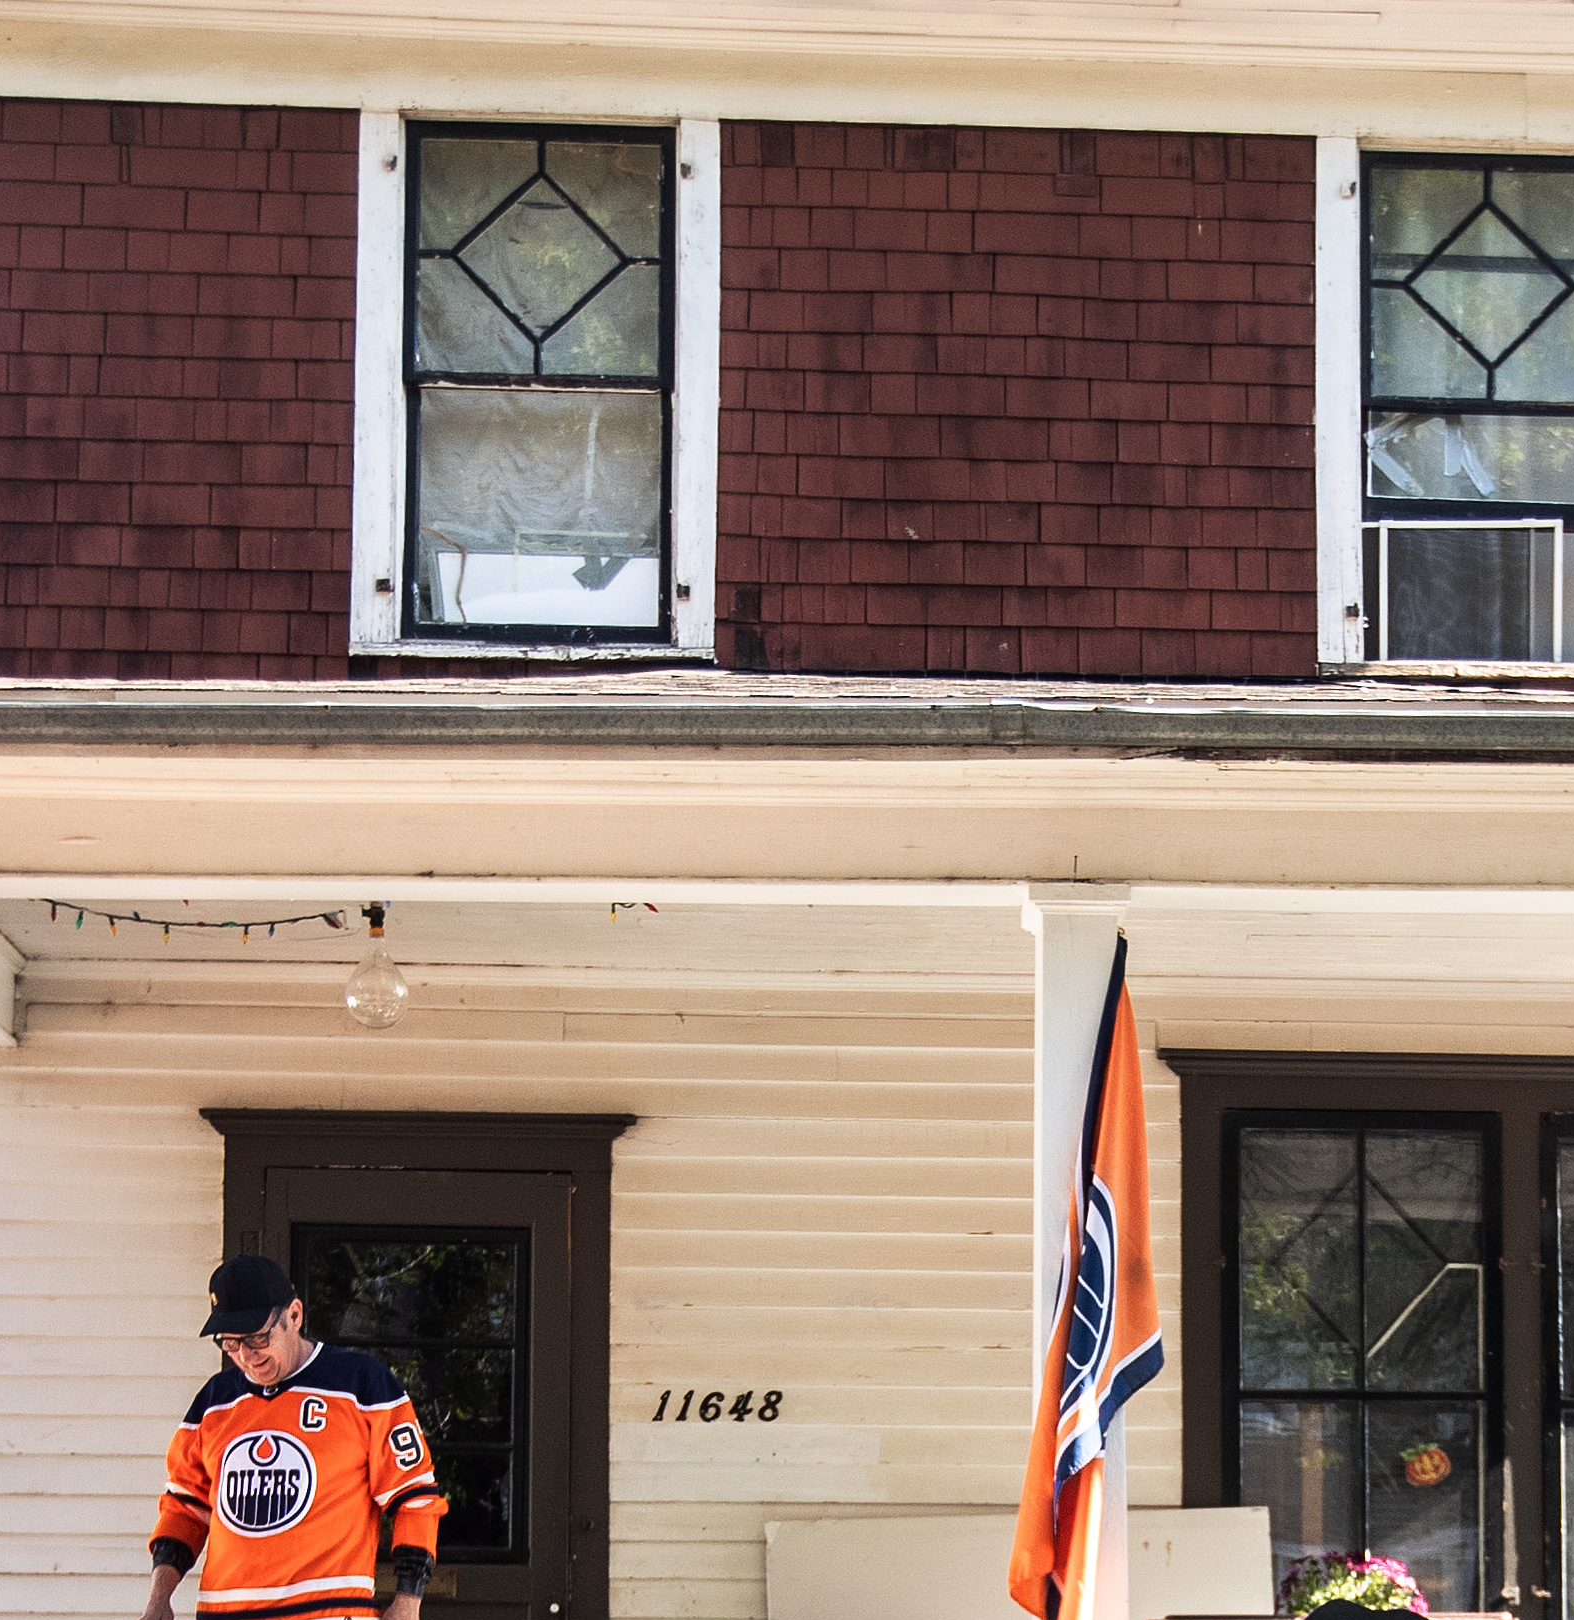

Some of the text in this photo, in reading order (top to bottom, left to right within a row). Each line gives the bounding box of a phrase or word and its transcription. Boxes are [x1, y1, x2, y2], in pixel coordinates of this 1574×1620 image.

[299, 1396, 327, 1432] C
[651, 1389, 783, 1422] 11648
[388, 1419, 424, 1472] 9
[226, 1468, 300, 1527] OILERS
